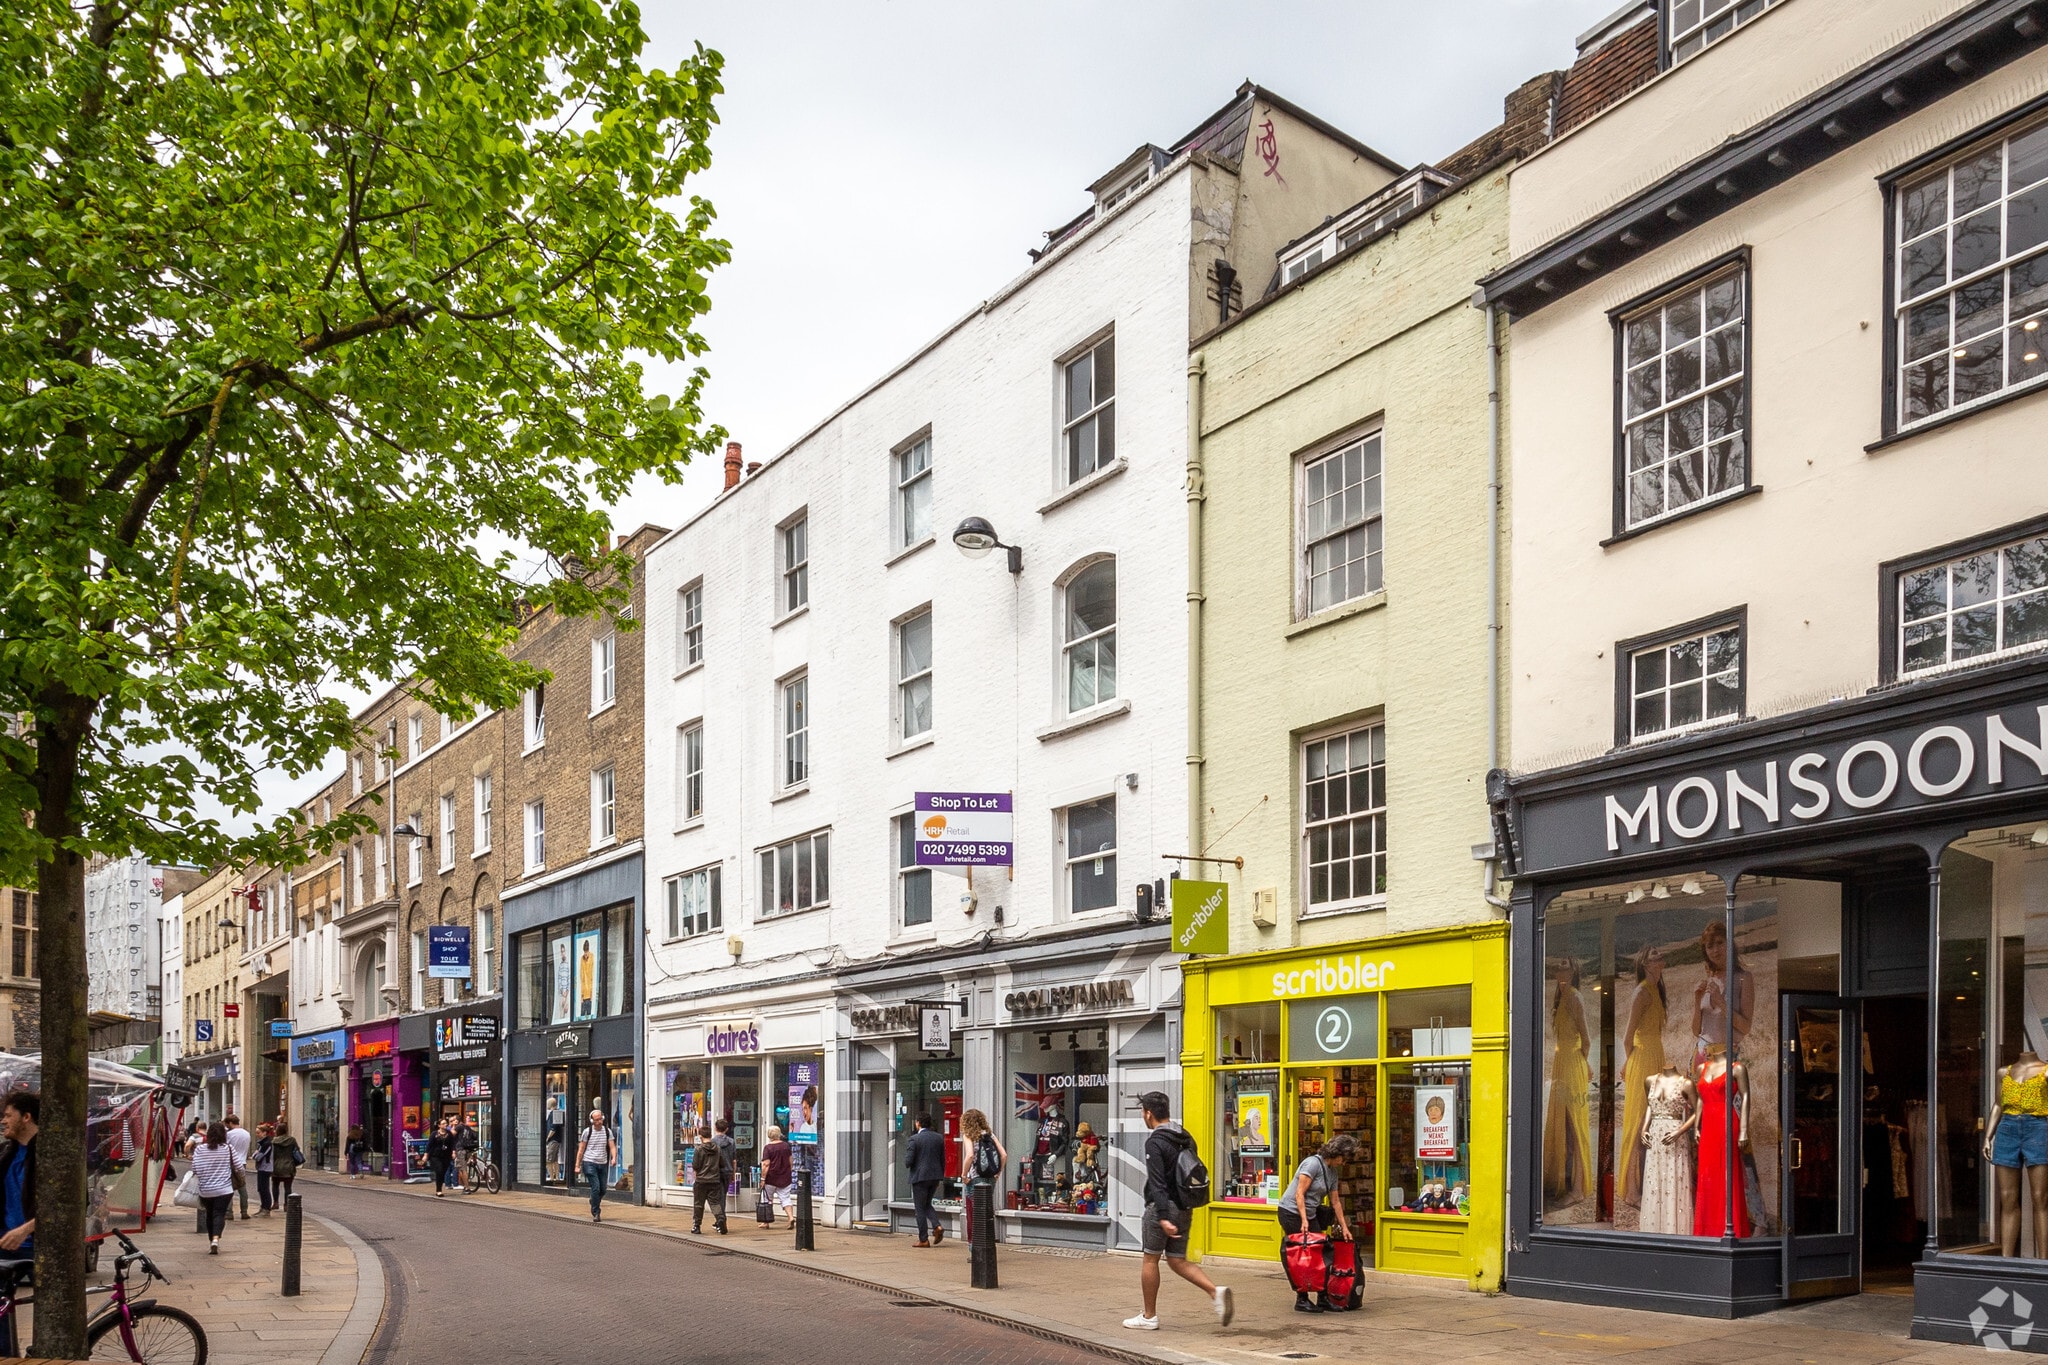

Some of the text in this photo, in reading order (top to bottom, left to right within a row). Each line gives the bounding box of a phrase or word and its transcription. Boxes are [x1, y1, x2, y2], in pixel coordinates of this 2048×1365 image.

[1604, 705, 2048, 851] MONSOON
[930, 796, 998, 810] Shop To Let
[924, 826, 970, 835] HRH Retail
[922, 844, 1007, 856] 020 7499 5399
[1179, 888, 1223, 947] scribbler
[1272, 955, 1395, 997] scribbler
[1004, 979, 1134, 1012] COOL BRITANNIA
[1325, 1013, 1342, 1043] 2
[555, 1031, 579, 1048] FATFACE
[707, 1021, 758, 1054] claire's
[930, 1080, 952, 1092] COOL
[1049, 1074, 1078, 1089] COOL
[1423, 1125, 1449, 1133] BREAKFAST
